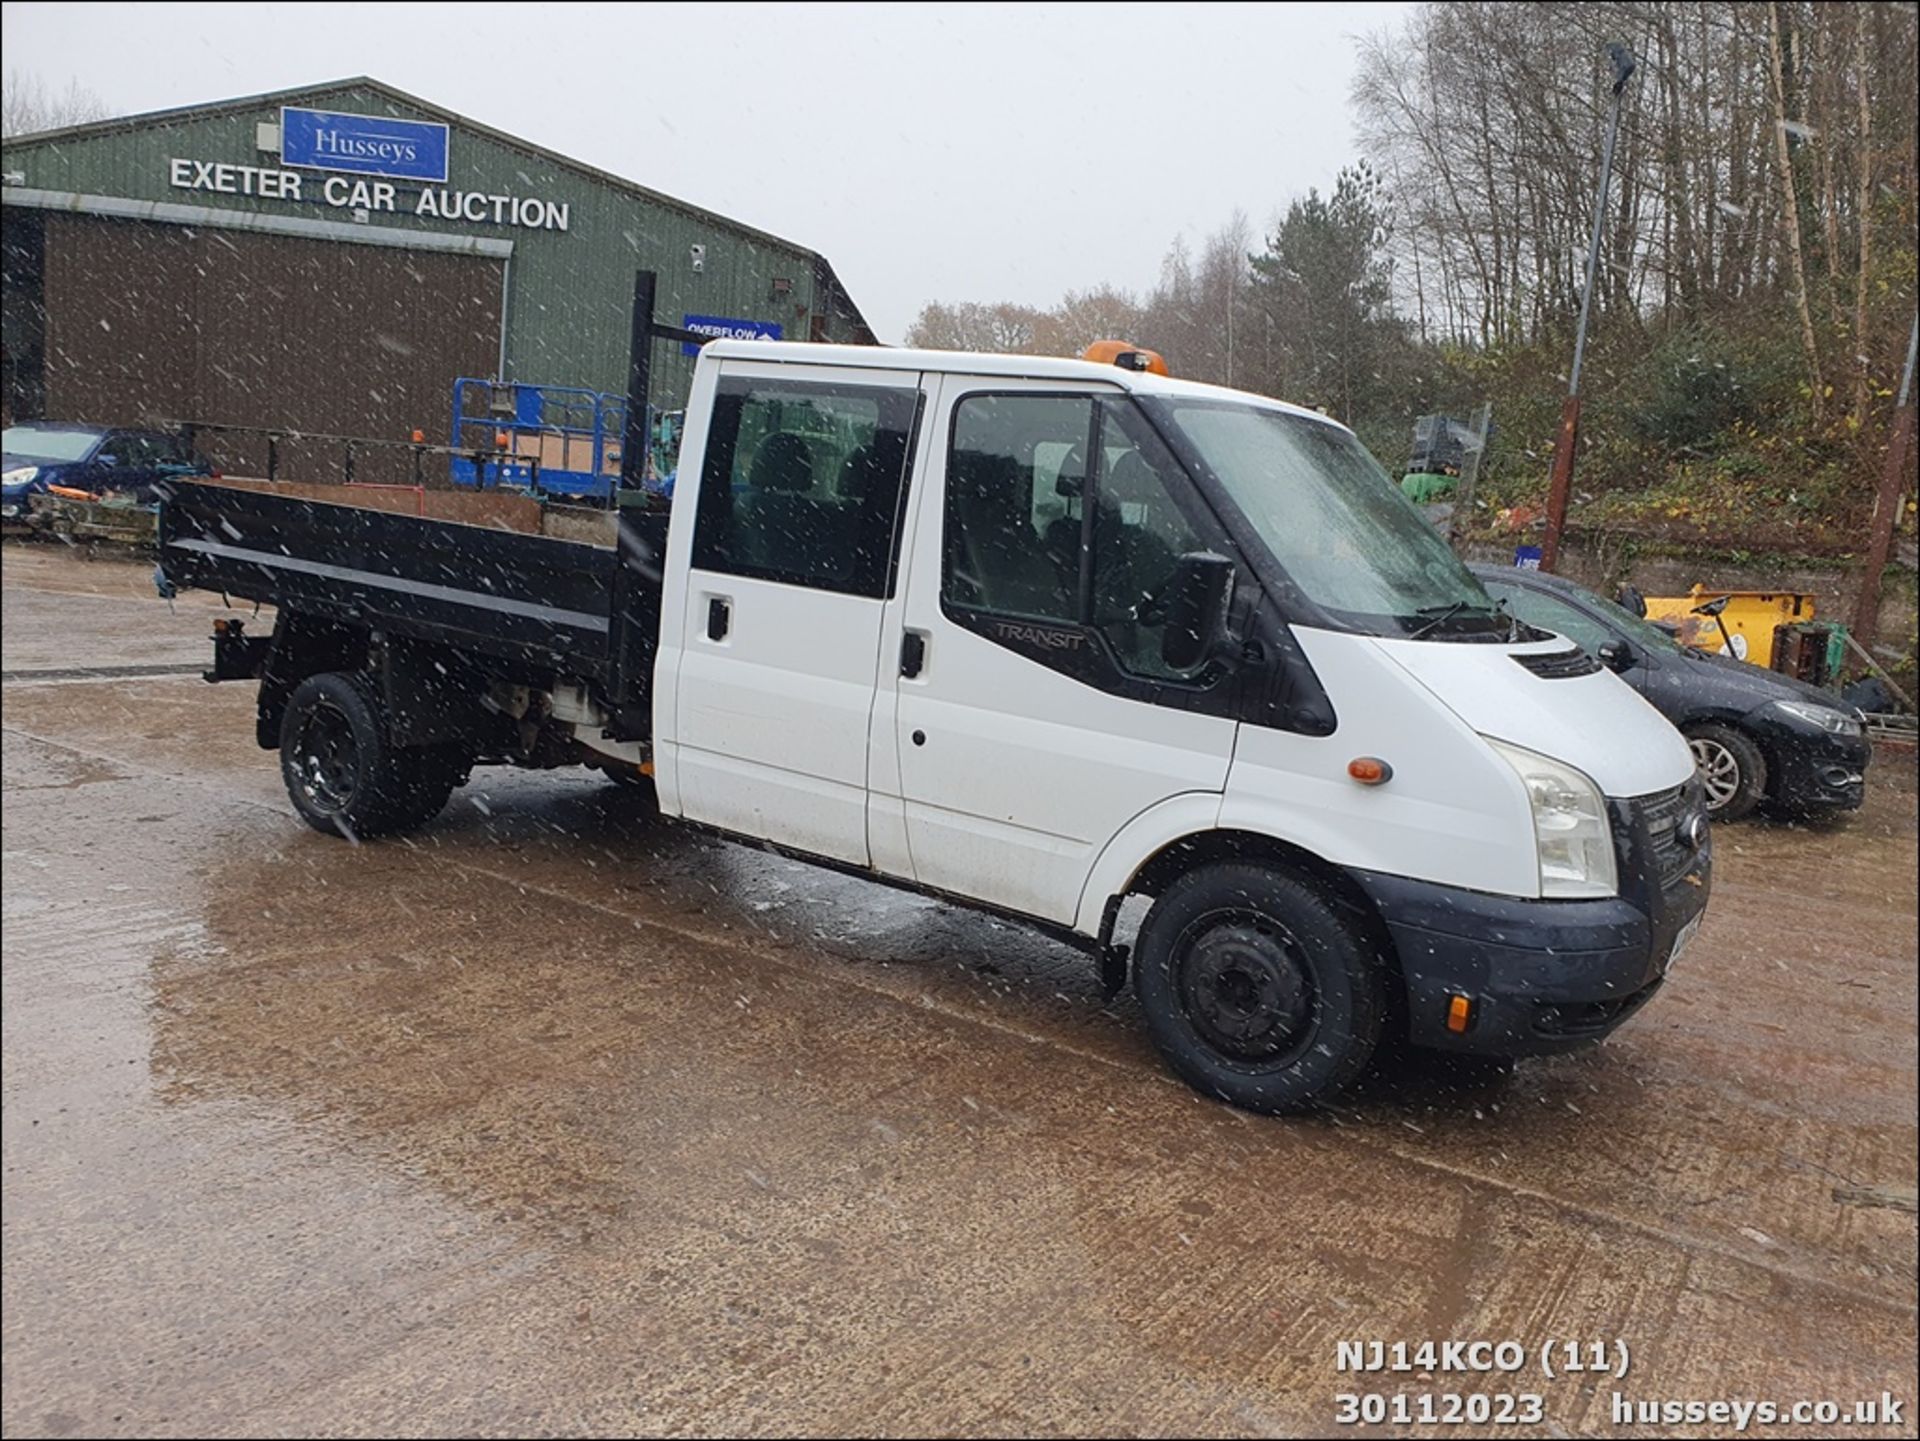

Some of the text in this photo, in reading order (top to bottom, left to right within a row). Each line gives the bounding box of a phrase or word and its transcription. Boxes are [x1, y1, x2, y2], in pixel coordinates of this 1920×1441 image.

[315, 128, 417, 163] Husseys
[170, 158, 570, 231] EXETER CAR AUCTION
[688, 323, 757, 340] OVERFLOW
[996, 623, 1085, 650] TRANSIT
